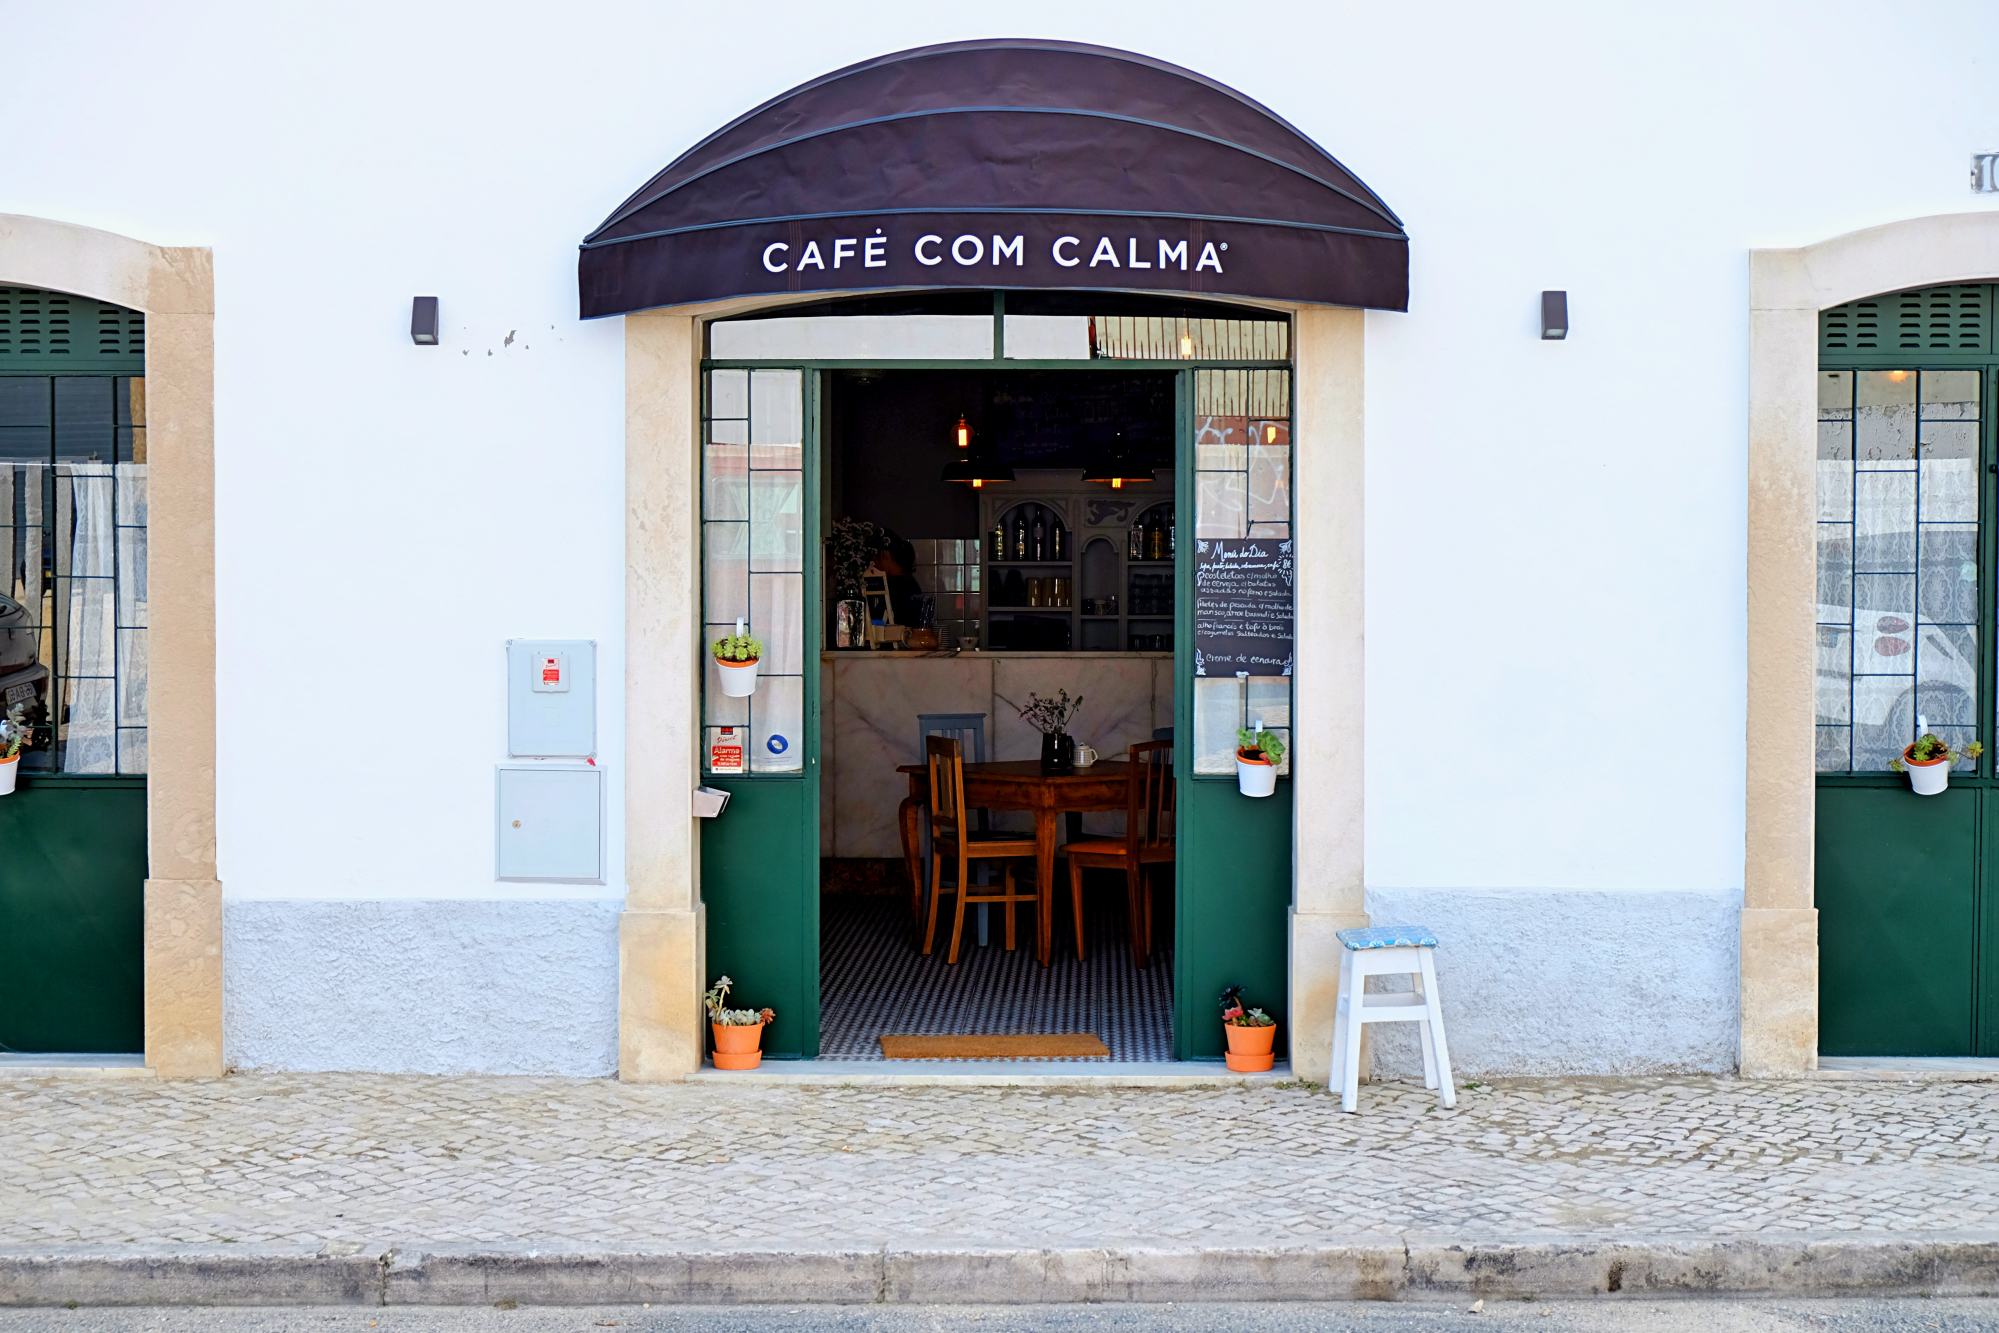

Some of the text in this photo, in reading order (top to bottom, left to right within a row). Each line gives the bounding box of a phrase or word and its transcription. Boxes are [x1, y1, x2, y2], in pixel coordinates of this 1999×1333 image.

[914, 234, 1025, 266] COM
[1249, 544, 1269, 558] Dia
[1235, 653, 1248, 663] de
